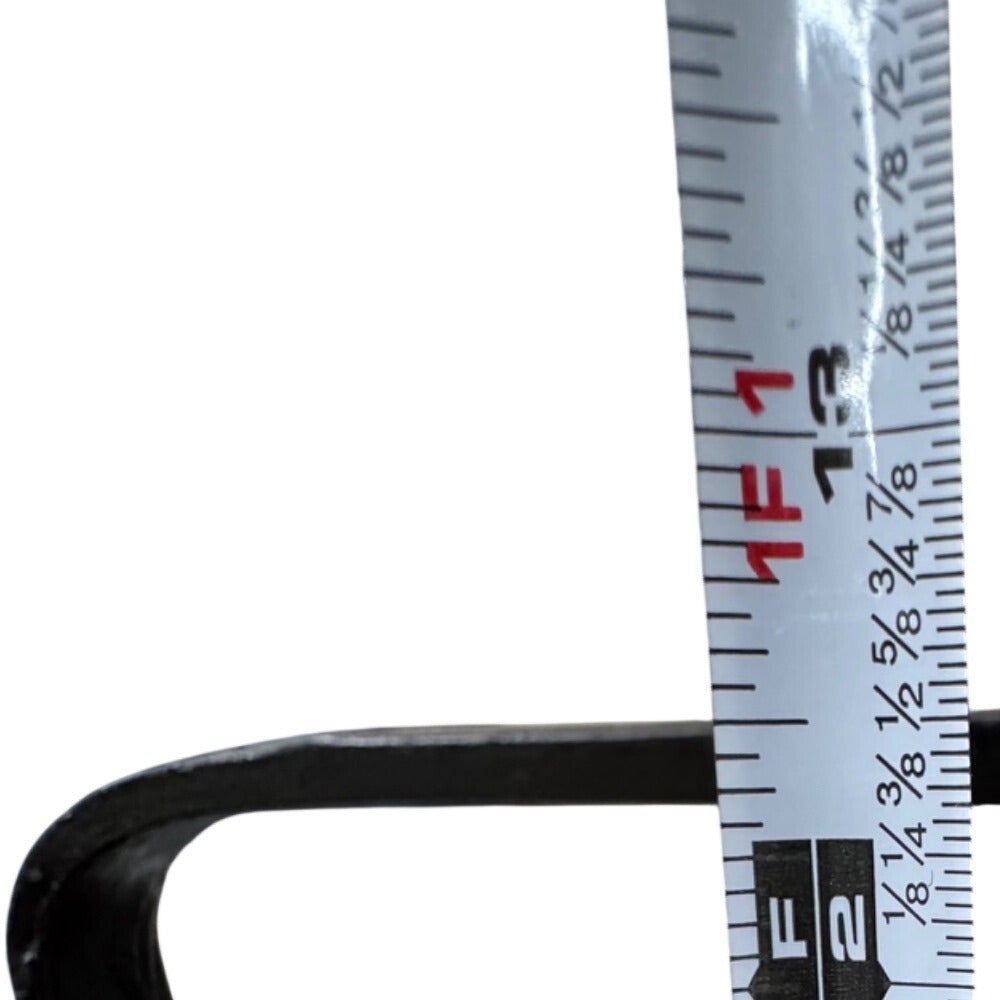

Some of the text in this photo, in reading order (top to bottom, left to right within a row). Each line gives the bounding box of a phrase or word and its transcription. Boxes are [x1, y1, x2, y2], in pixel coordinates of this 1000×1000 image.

[808, 346, 853, 504] 13
[866, 463, 917, 521] 7/8
[868, 538, 919, 595] 3/4
[870, 607, 922, 666] 5/8
[873, 681, 924, 731] 1/2
[875, 751, 926, 806] 3/8
[878, 822, 927, 867] 1/4
[881, 881, 929, 926] 1/8
